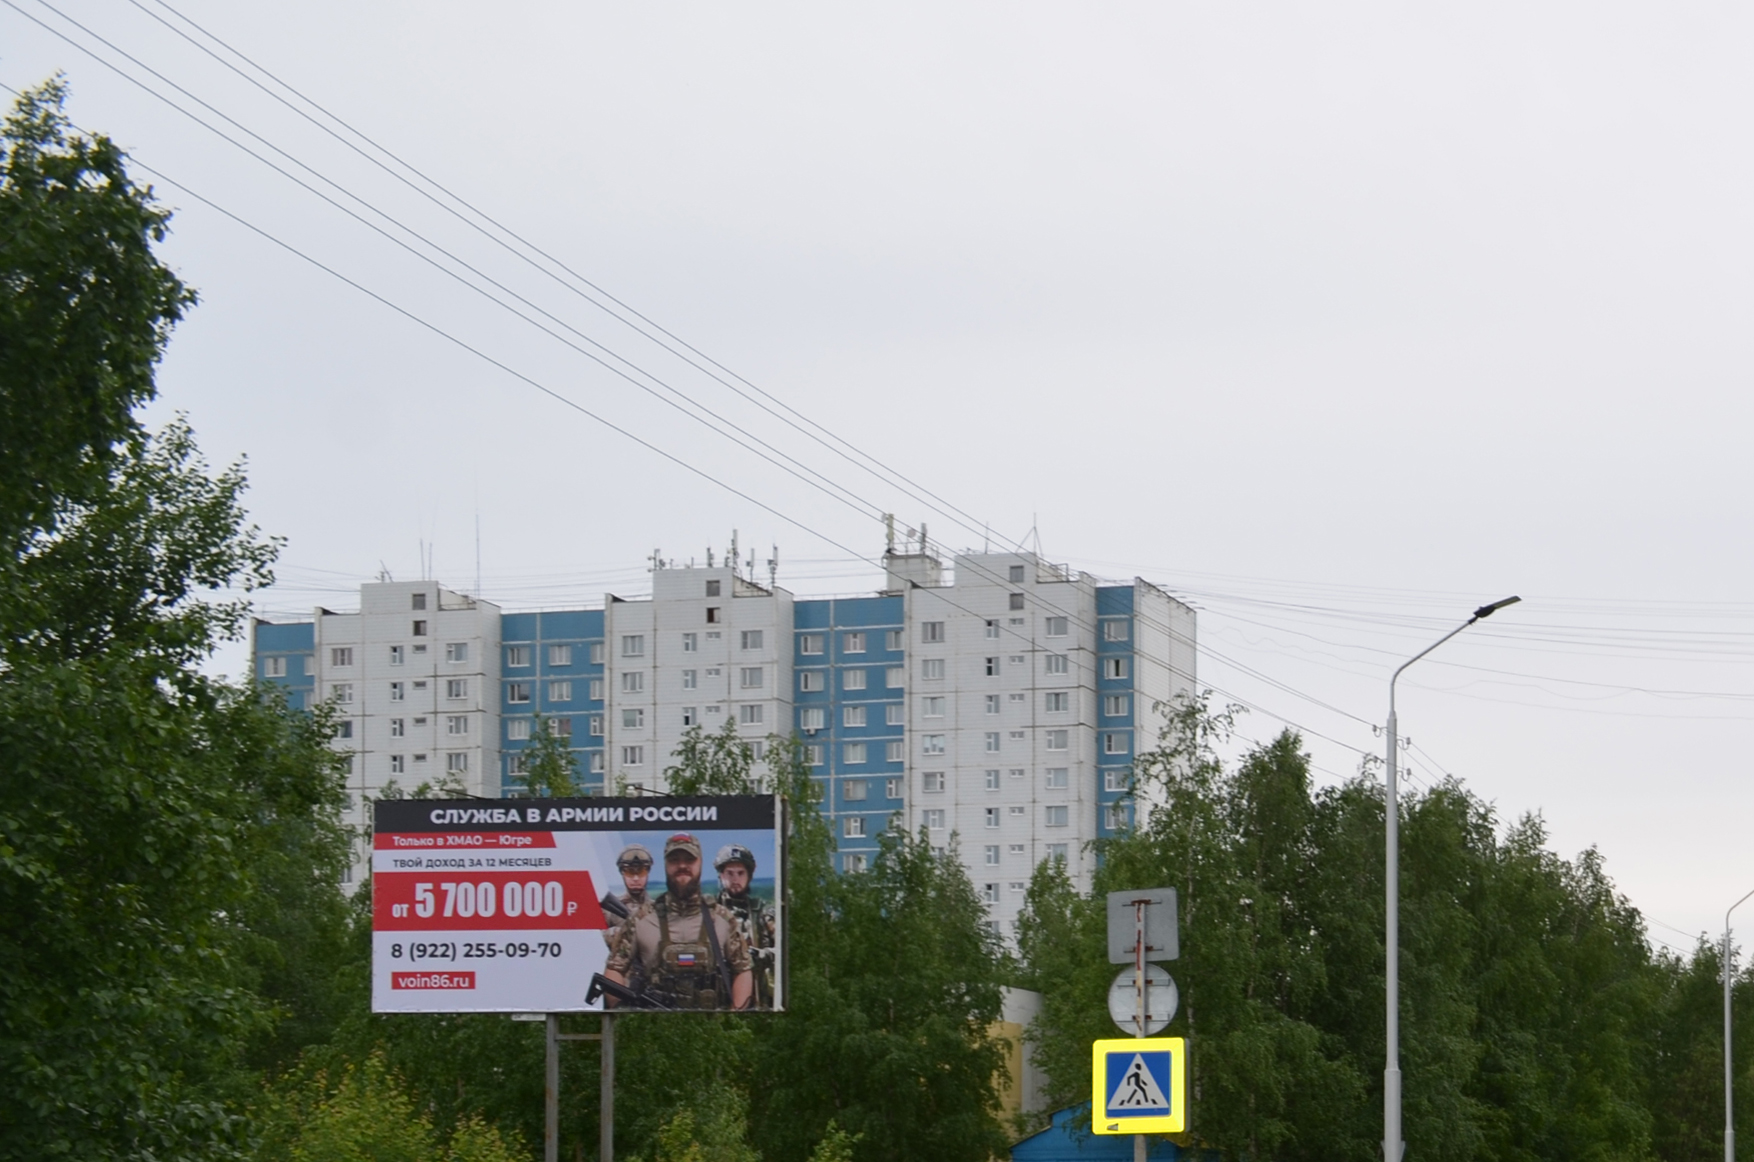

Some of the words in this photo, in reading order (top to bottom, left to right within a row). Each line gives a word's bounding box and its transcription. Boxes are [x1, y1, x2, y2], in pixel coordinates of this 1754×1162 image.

[430, 808, 522, 824] СЛУЖБА
[526, 808, 541, 823] В
[545, 807, 624, 823] АРМИИ
[629, 806, 718, 822] РОССИИ
[392, 835, 435, 846] Только
[436, 837, 444, 845] в
[446, 835, 483, 846] ХМАО
[499, 835, 532, 847] Югре
[393, 857, 423, 868] ТВОЙ
[425, 859, 466, 869] ДОХОД
[469, 858, 483, 867] ЗА
[486, 858, 496, 867] 12
[499, 857, 552, 868] МЕСЯЦЕВ
[415, 882, 435, 918] 5
[440, 881, 496, 918] 700
[503, 881, 564, 918] 000
[391, 943, 403, 958] 8
[409, 942, 457, 962] (922)
[463, 942, 562, 959] 255-09-70
[398, 974, 470, 988] voin86.ru
